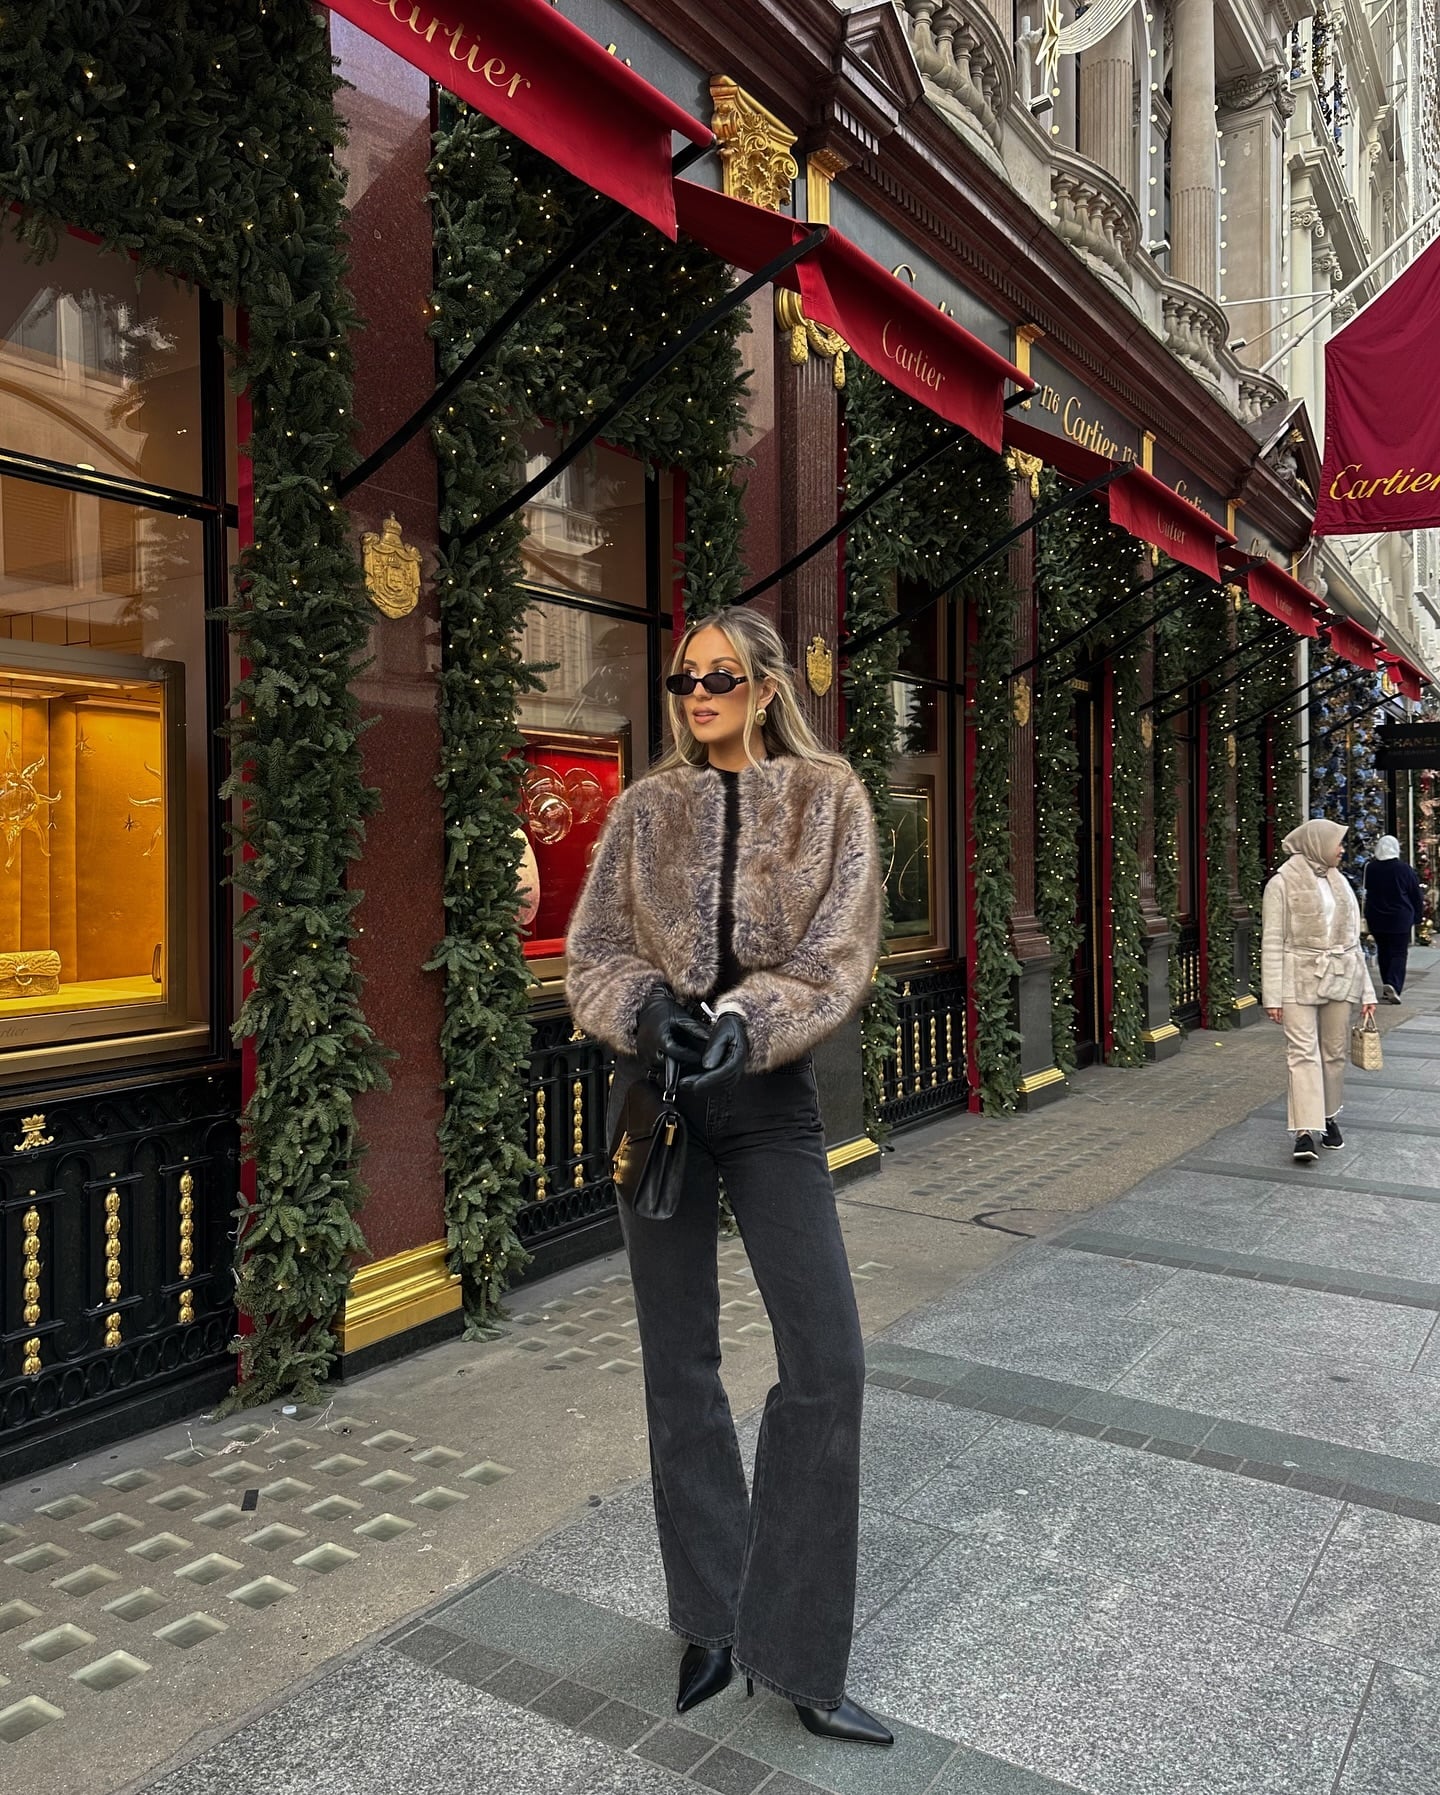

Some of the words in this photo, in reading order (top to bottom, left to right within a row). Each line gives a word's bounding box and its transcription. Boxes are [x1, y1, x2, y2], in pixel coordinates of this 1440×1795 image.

[372, 0, 531, 98] artier
[882, 319, 946, 391] Cartier
[1041, 385, 1060, 414] 176
[1062, 396, 1118, 460] Cartier
